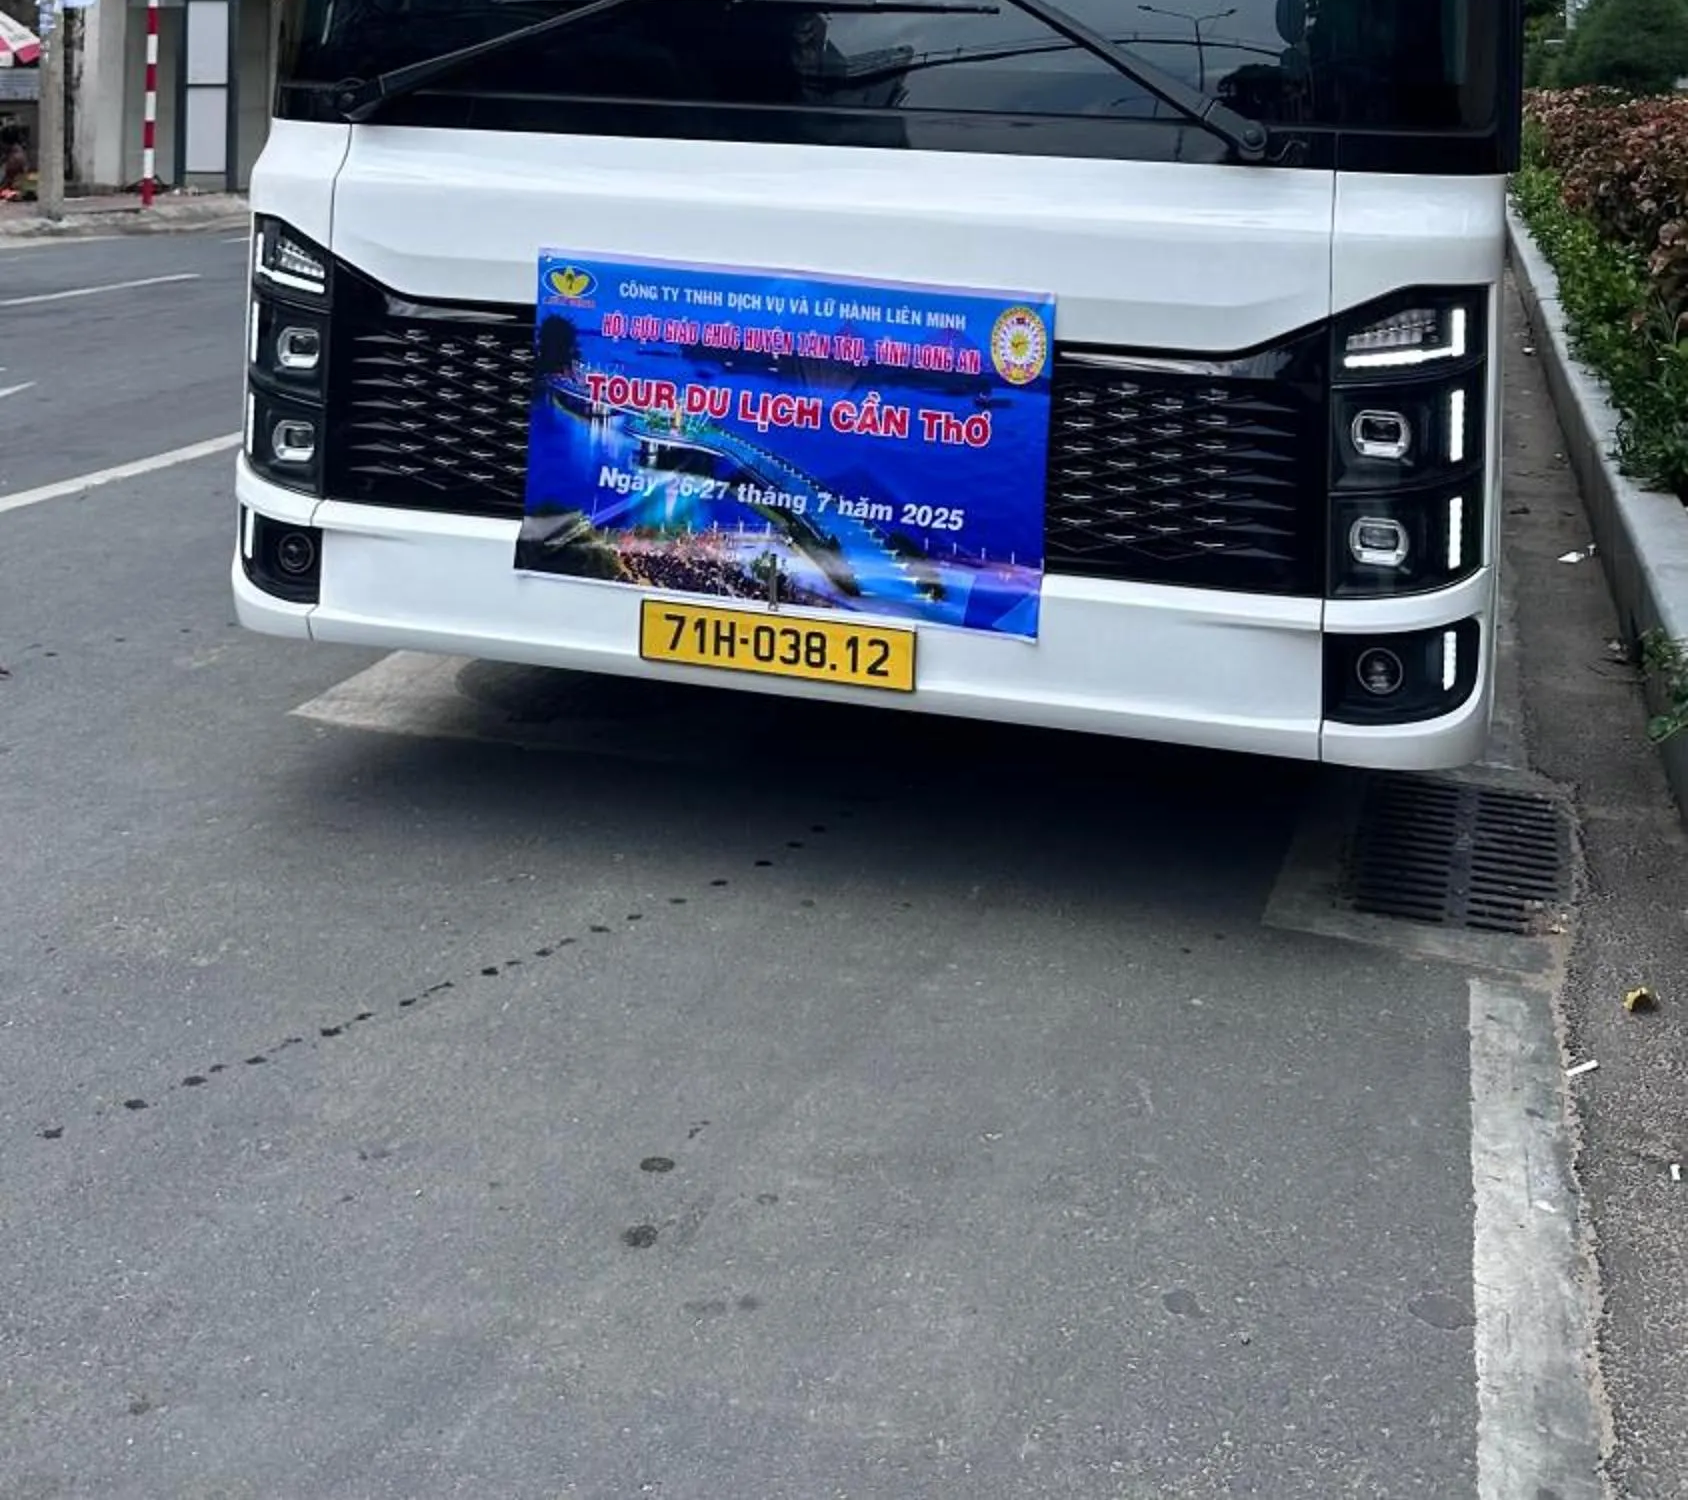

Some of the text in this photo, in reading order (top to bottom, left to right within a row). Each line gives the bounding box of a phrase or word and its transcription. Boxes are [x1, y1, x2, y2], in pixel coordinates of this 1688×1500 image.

[619, 280, 658, 299] CÔNG
[662, 286, 680, 302] TY
[683, 288, 723, 307] TNHH
[728, 292, 761, 312] DỊCH
[765, 297, 785, 315] VỤ
[789, 296, 808, 315] VÀ
[926, 311, 966, 331] MINH
[913, 343, 953, 371] LONG
[955, 348, 982, 375] AN
[585, 373, 677, 411] TOUR
[685, 385, 732, 417] DU
[739, 392, 822, 432] LỊCH
[829, 391, 910, 439] CẦN
[599, 466, 965, 532] Ngày 26-27 tháng 7 năm 2025
[664, 613, 890, 677] 71H-038.12
